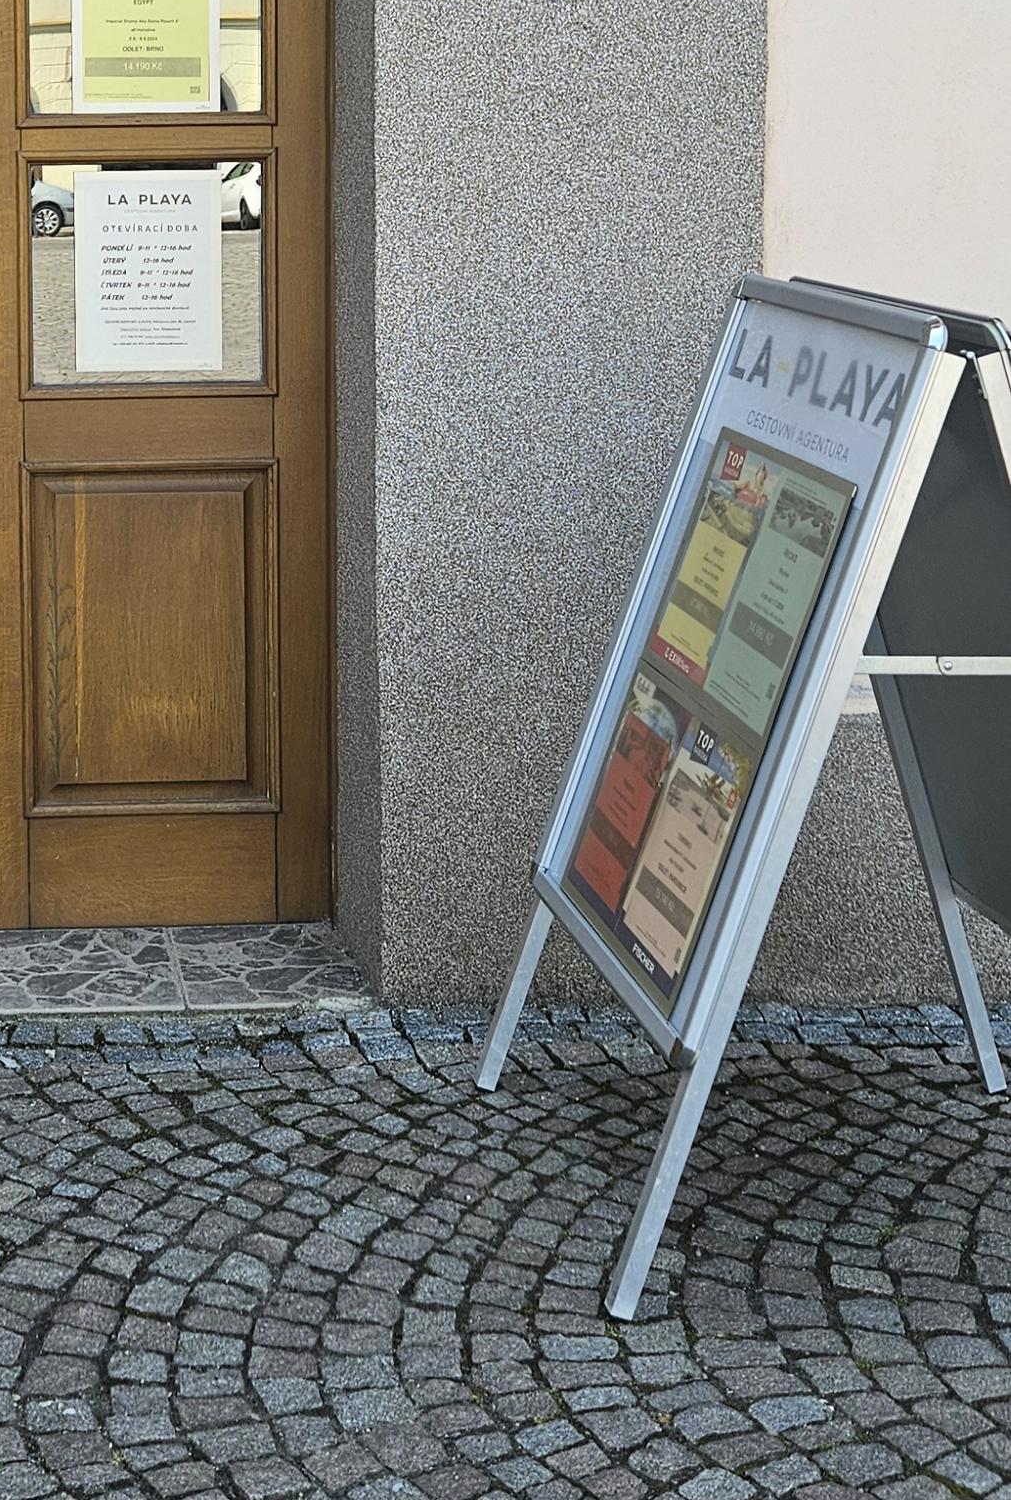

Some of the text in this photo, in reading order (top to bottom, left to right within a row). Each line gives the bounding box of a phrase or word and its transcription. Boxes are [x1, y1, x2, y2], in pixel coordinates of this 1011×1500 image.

[108, 194, 192, 205] LA PLAYA
[102, 222, 198, 233] OTEVÍRACÍ DOBA
[103, 256, 126, 264] ÚTERÝ
[729, 328, 907, 429] LA PLAYA
[746, 410, 850, 464] CESTOVNÍ AGENTURA
[727, 450, 744, 470] TOP
[696, 729, 716, 753] TOP
[632, 942, 656, 975] FISCHER
